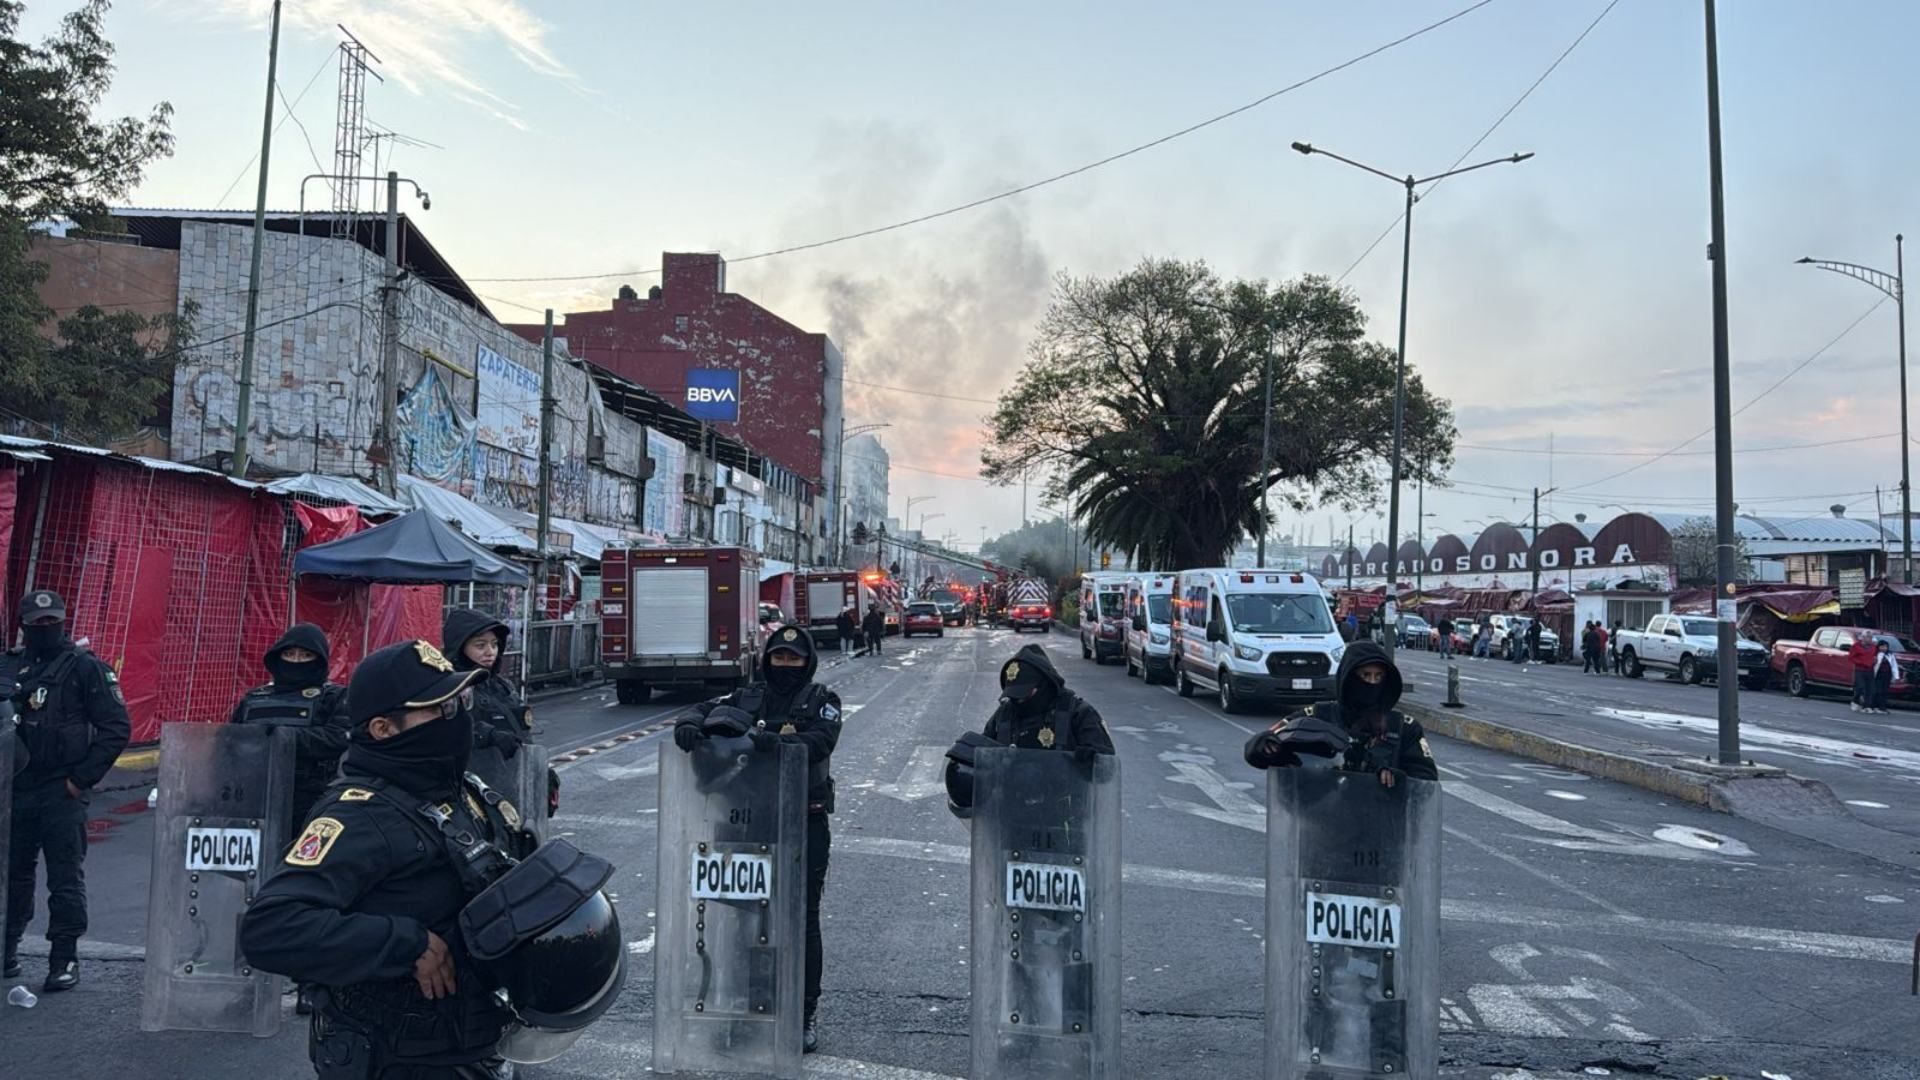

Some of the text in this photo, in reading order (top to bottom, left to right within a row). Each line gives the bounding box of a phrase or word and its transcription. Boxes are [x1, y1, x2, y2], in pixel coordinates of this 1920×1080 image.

[480, 347, 540, 393] ZAPATERIA
[688, 387, 736, 402] BBVA
[1338, 543, 1636, 577] MERCADO SONORA
[190, 834, 254, 866] POLICIA
[696, 859, 766, 894] POLICIA
[1013, 868, 1082, 907] POLICIA
[1313, 900, 1394, 943] POLICIA
